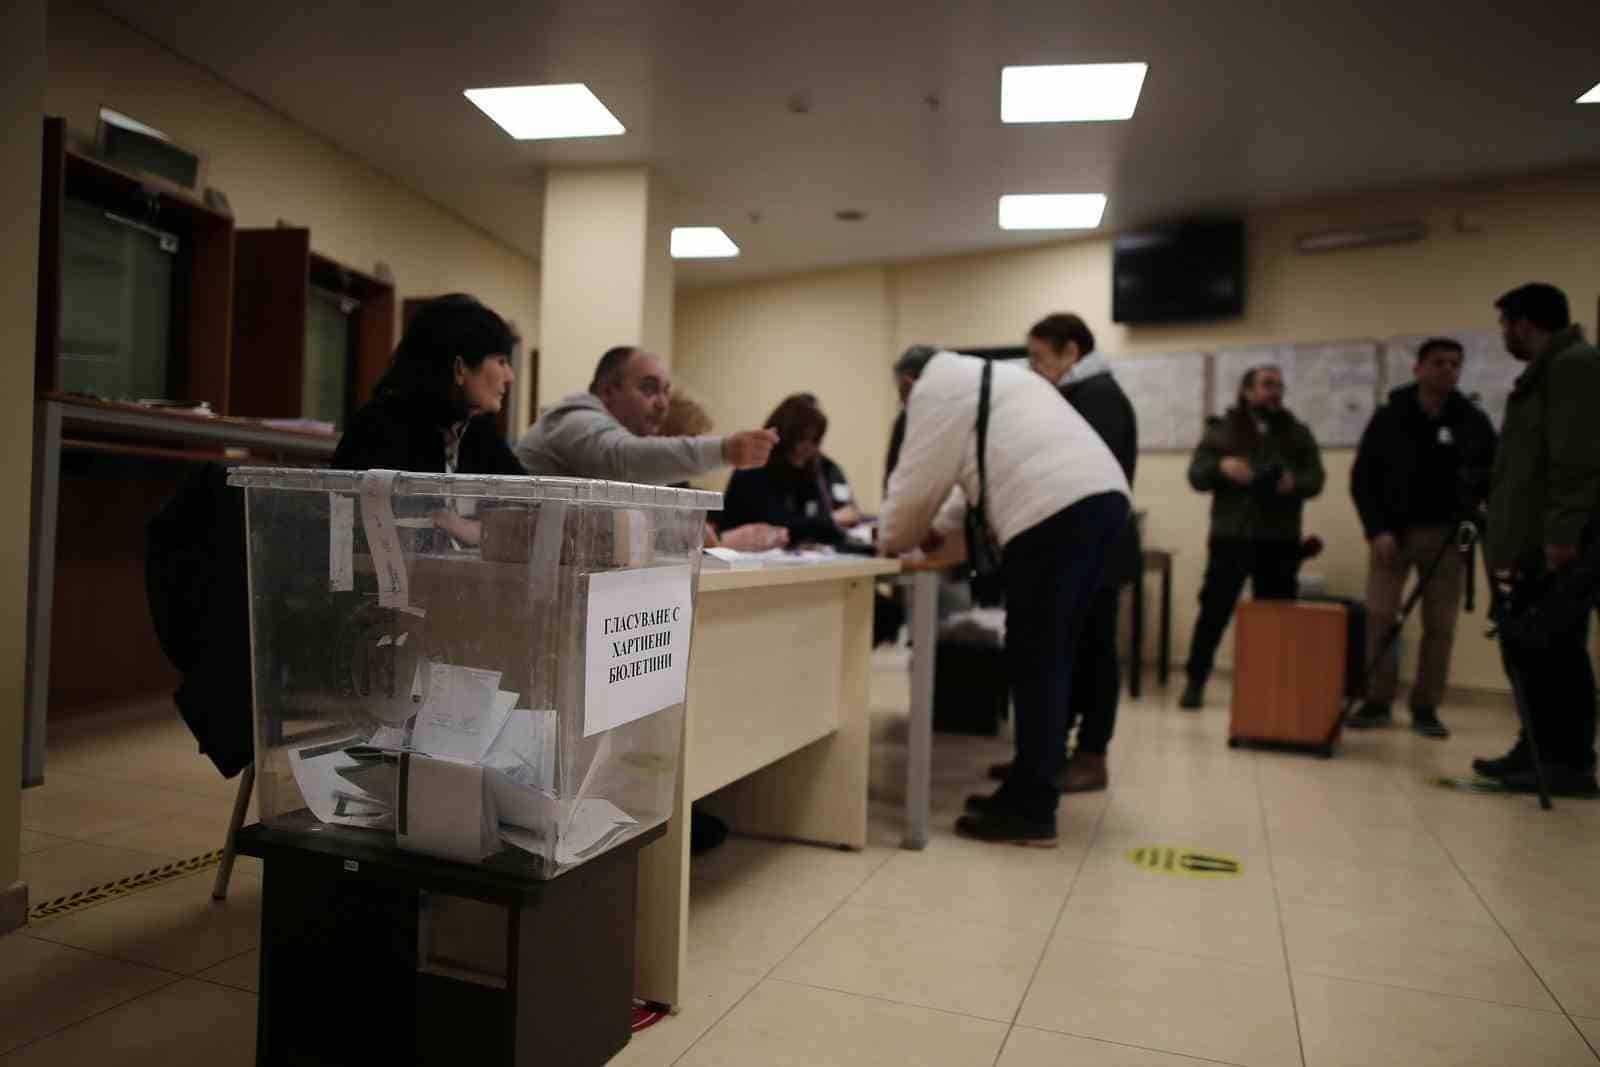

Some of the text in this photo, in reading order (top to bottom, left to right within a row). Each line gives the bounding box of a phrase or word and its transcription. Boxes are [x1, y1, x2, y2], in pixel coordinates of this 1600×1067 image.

[604, 606, 680, 635] ГЛАСУВАНЕ С
[612, 631, 671, 658] ХАРТИЕНИ
[608, 653, 672, 683] БЮЛЕТИНИ
